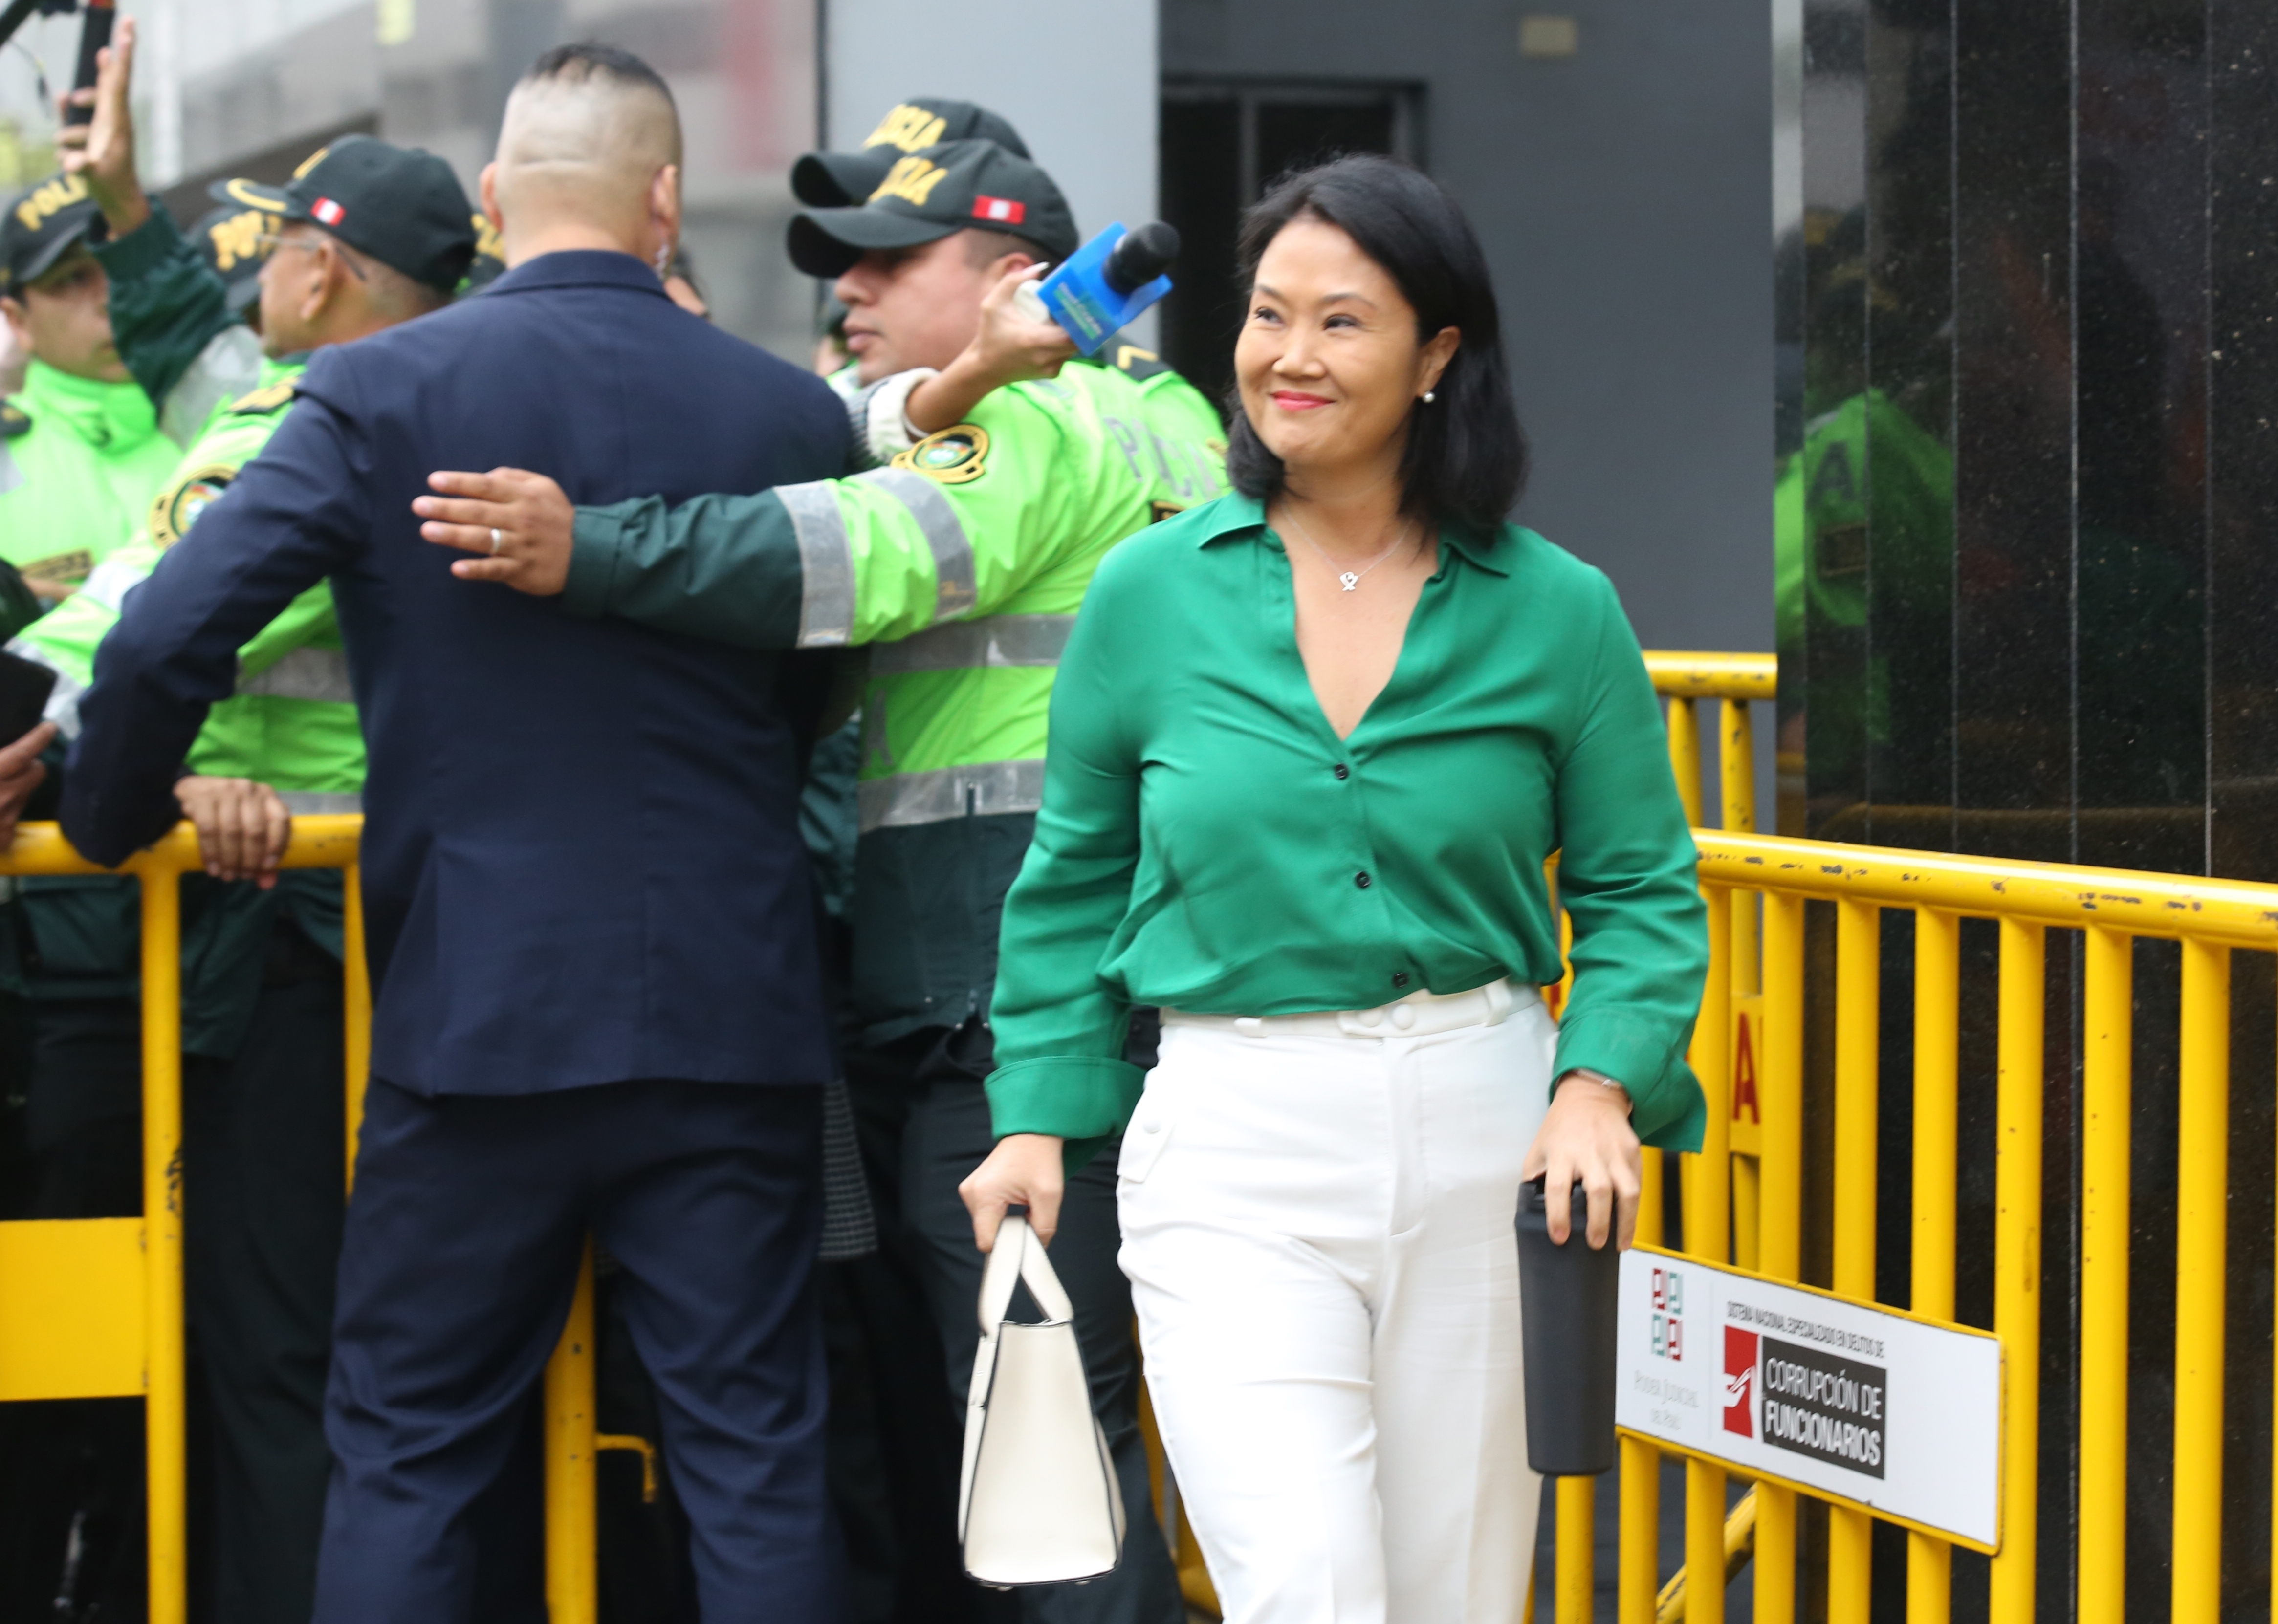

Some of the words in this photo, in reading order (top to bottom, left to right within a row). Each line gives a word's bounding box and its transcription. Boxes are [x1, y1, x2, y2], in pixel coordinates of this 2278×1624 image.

[1766, 1357, 1859, 1413] CORRUPCIÓN
[1861, 1384, 1882, 1420] DE
[1765, 1399, 1881, 1466] FUNCIONARIOS
